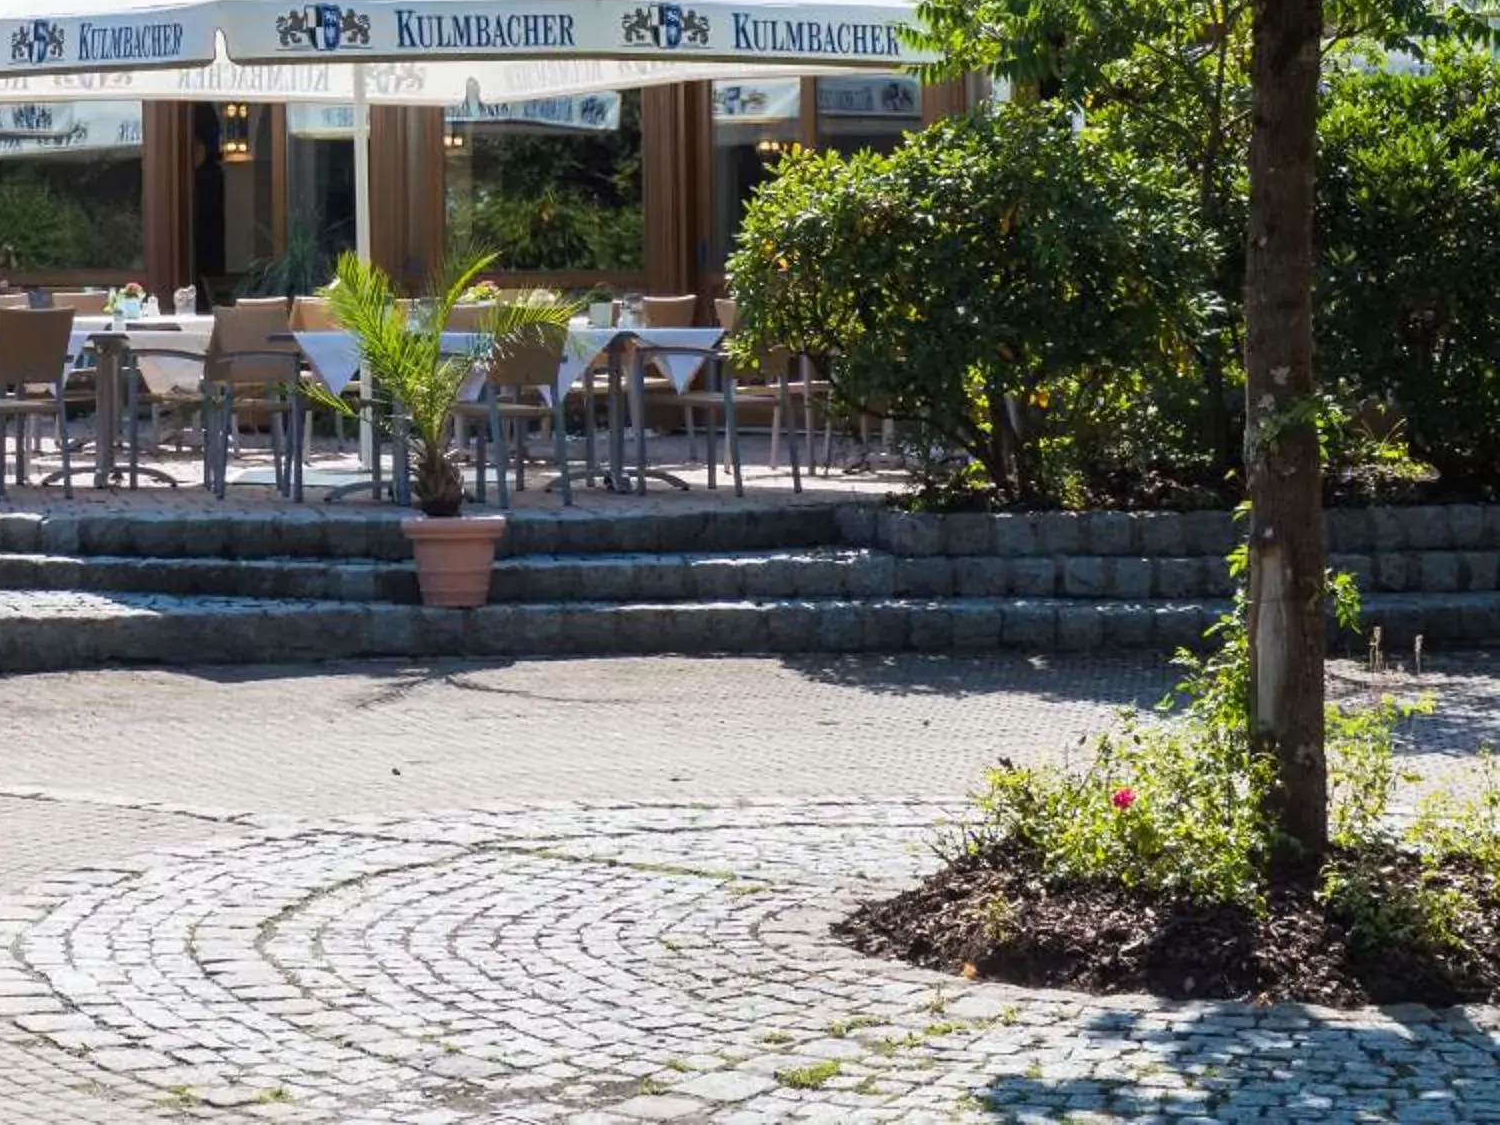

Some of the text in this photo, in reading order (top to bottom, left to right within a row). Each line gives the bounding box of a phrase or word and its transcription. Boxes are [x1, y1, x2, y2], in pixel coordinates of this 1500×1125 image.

[78, 22, 183, 61] KULMBACHER
[394, 9, 575, 47] KULMBACHER
[731, 12, 899, 55] KULMBACHER
